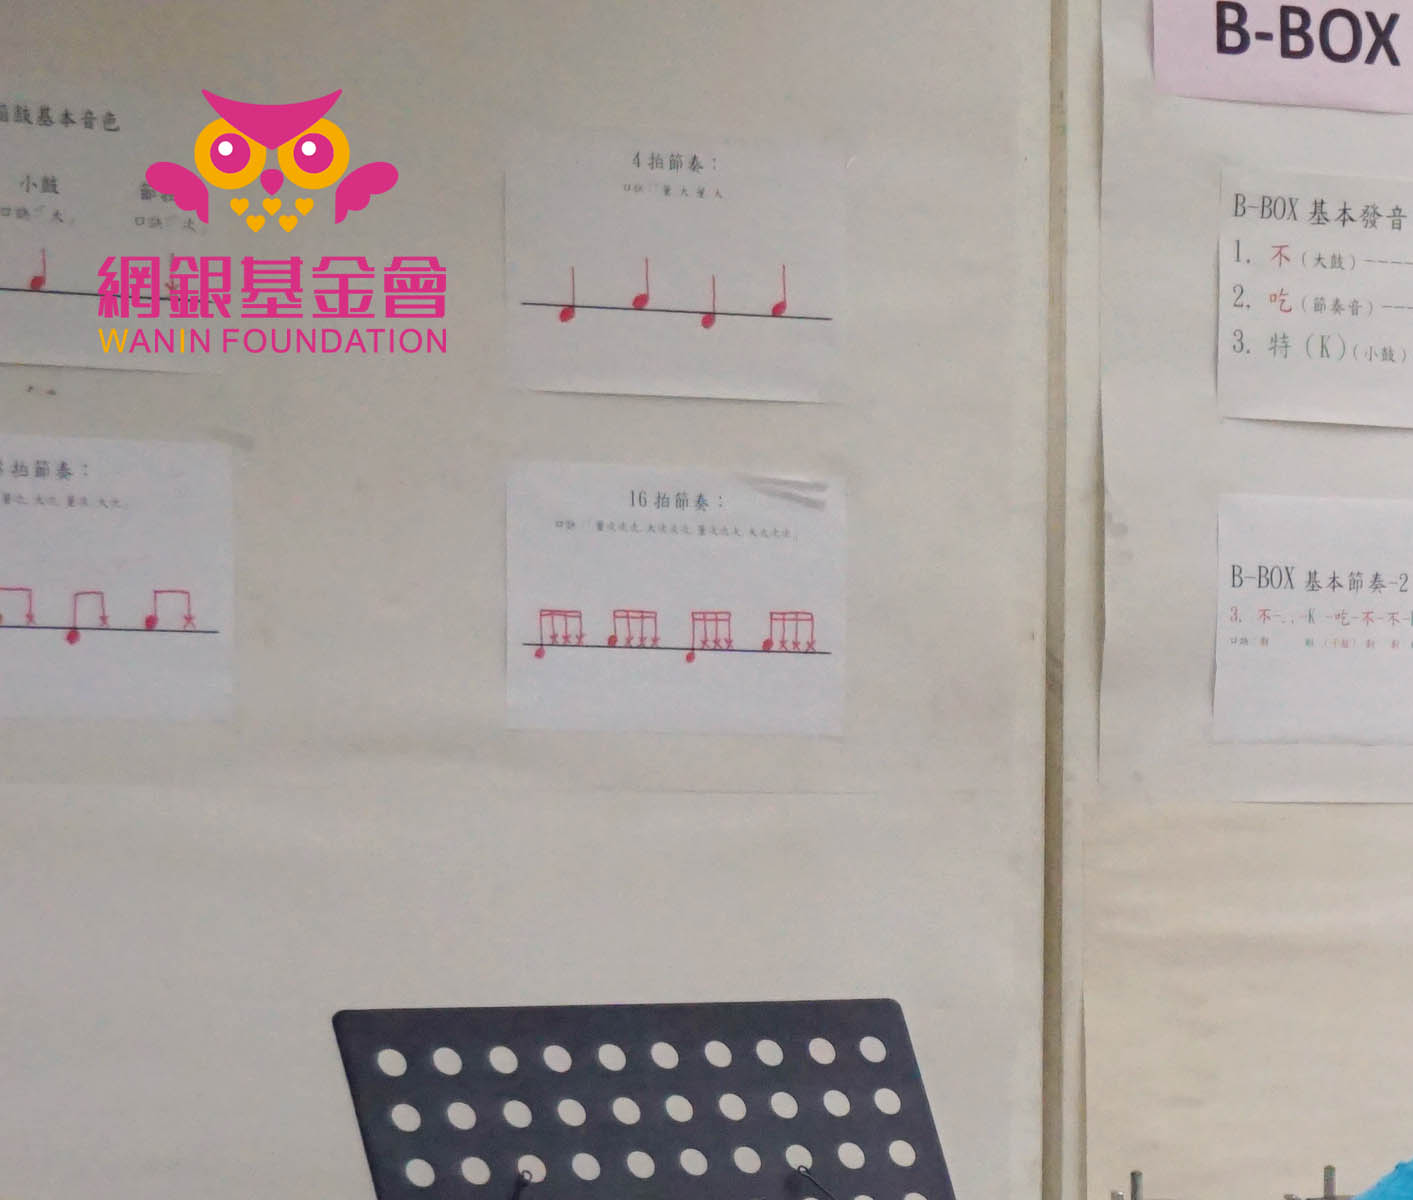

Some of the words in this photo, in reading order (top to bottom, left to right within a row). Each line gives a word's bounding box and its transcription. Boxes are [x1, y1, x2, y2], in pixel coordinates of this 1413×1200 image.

[1216, 1, 1401, 66] B-BOX
[1233, 193, 1298, 221] B-BOX
[1231, 564, 1296, 590] B-BOX
